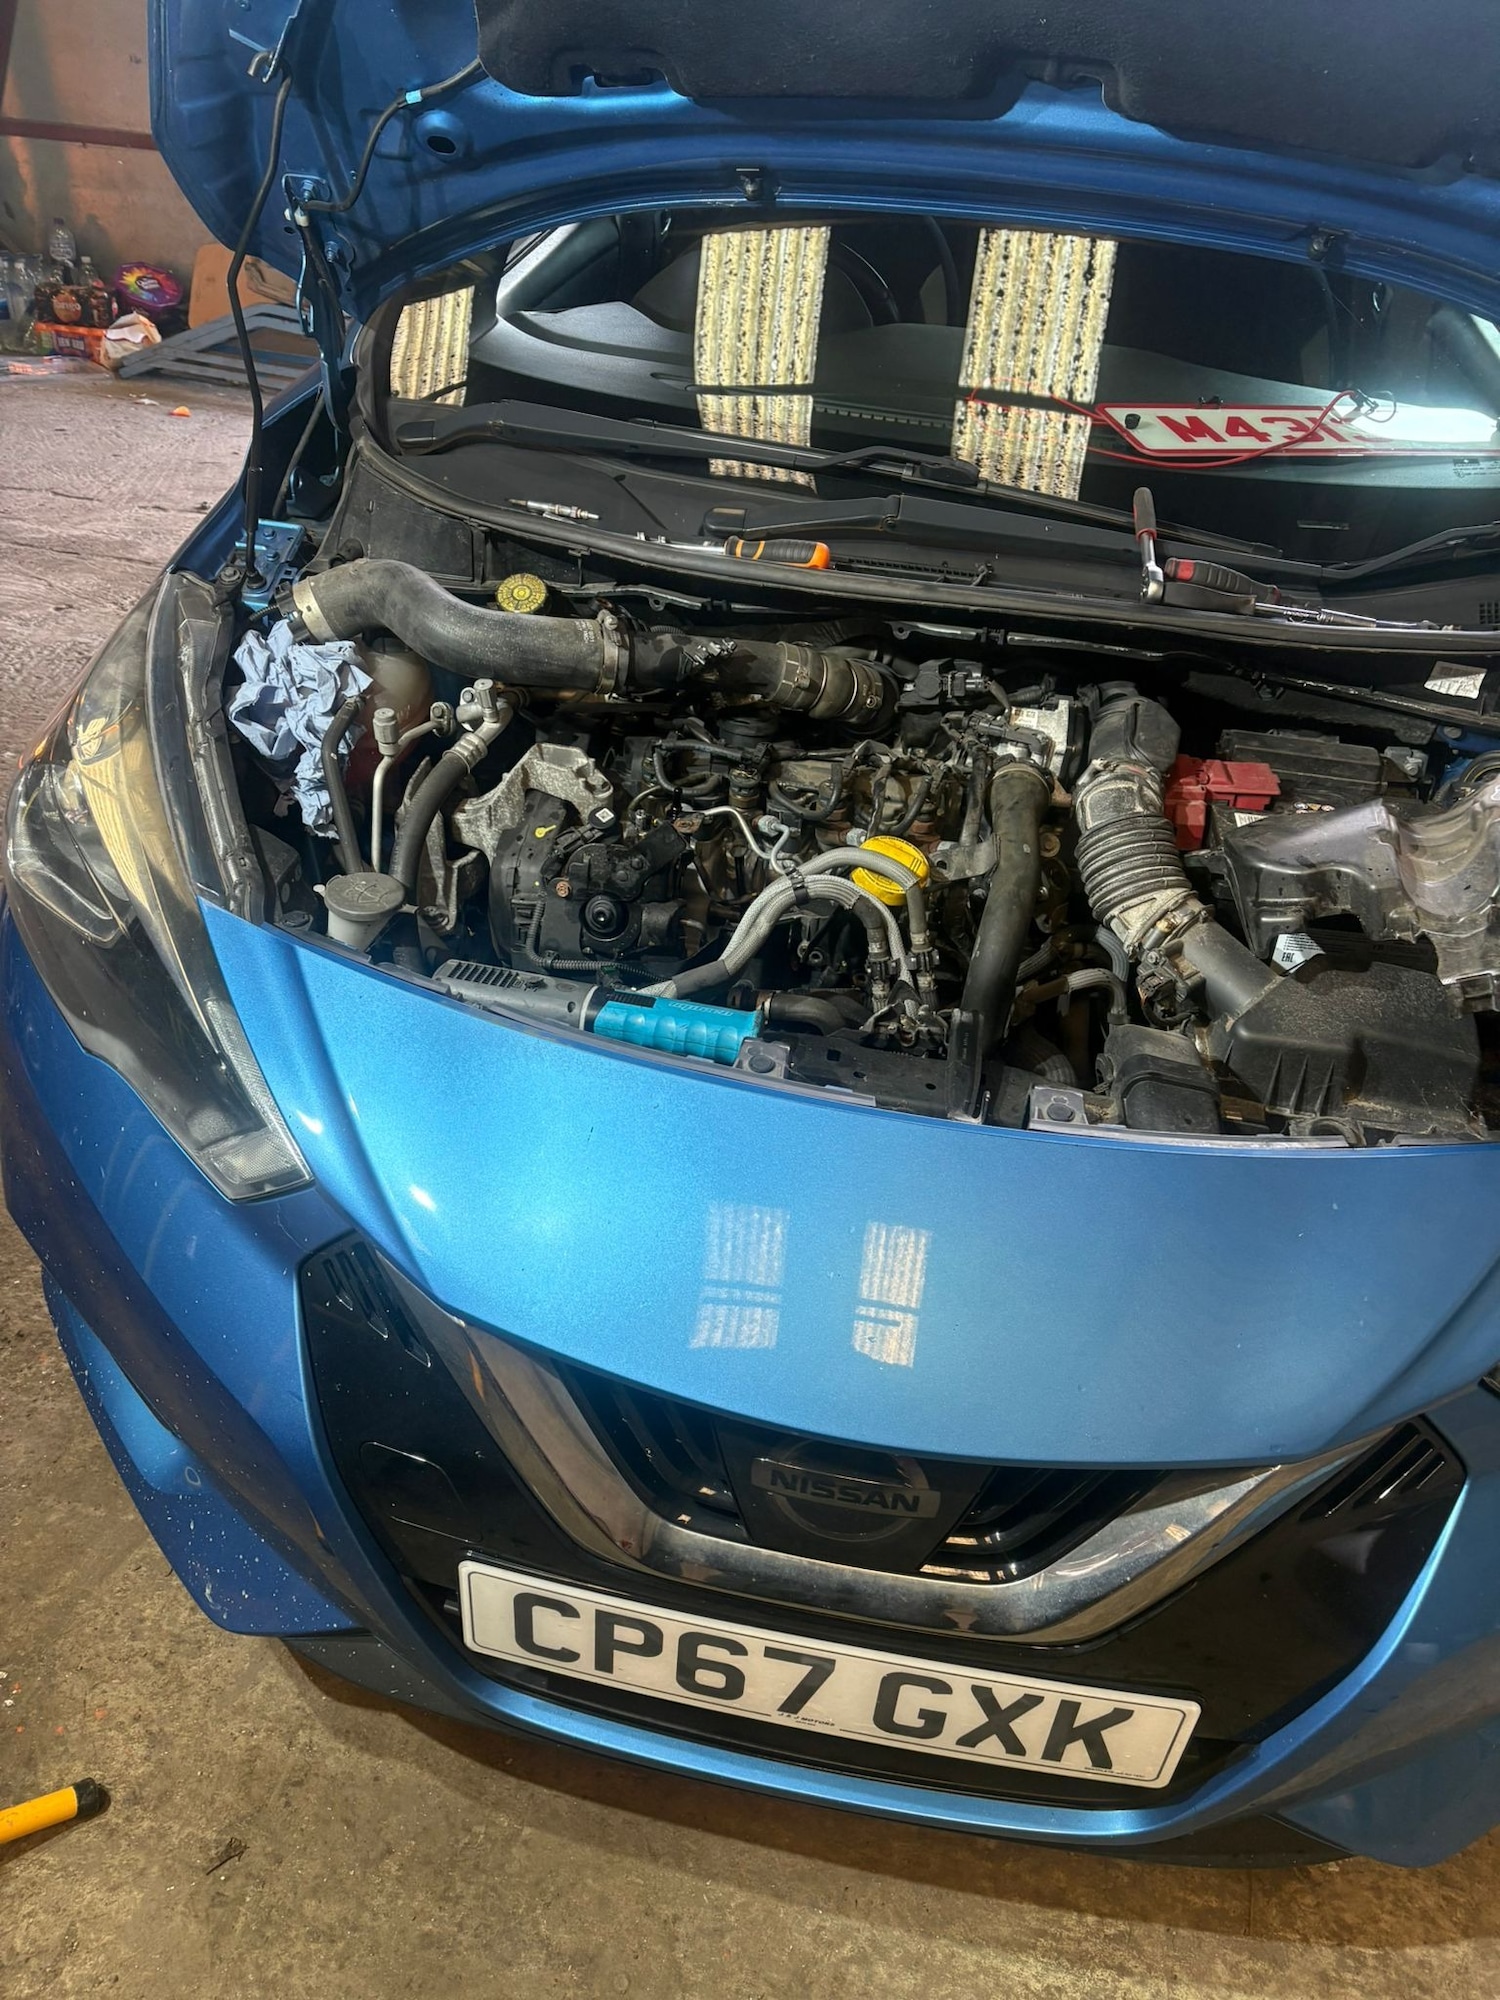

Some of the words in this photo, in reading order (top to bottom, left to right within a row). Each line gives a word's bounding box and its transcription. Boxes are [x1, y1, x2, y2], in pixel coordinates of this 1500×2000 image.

[770, 1469, 920, 1513] NISSAN
[513, 1591, 836, 1715] CP67
[872, 1671, 1134, 1770] GXK
